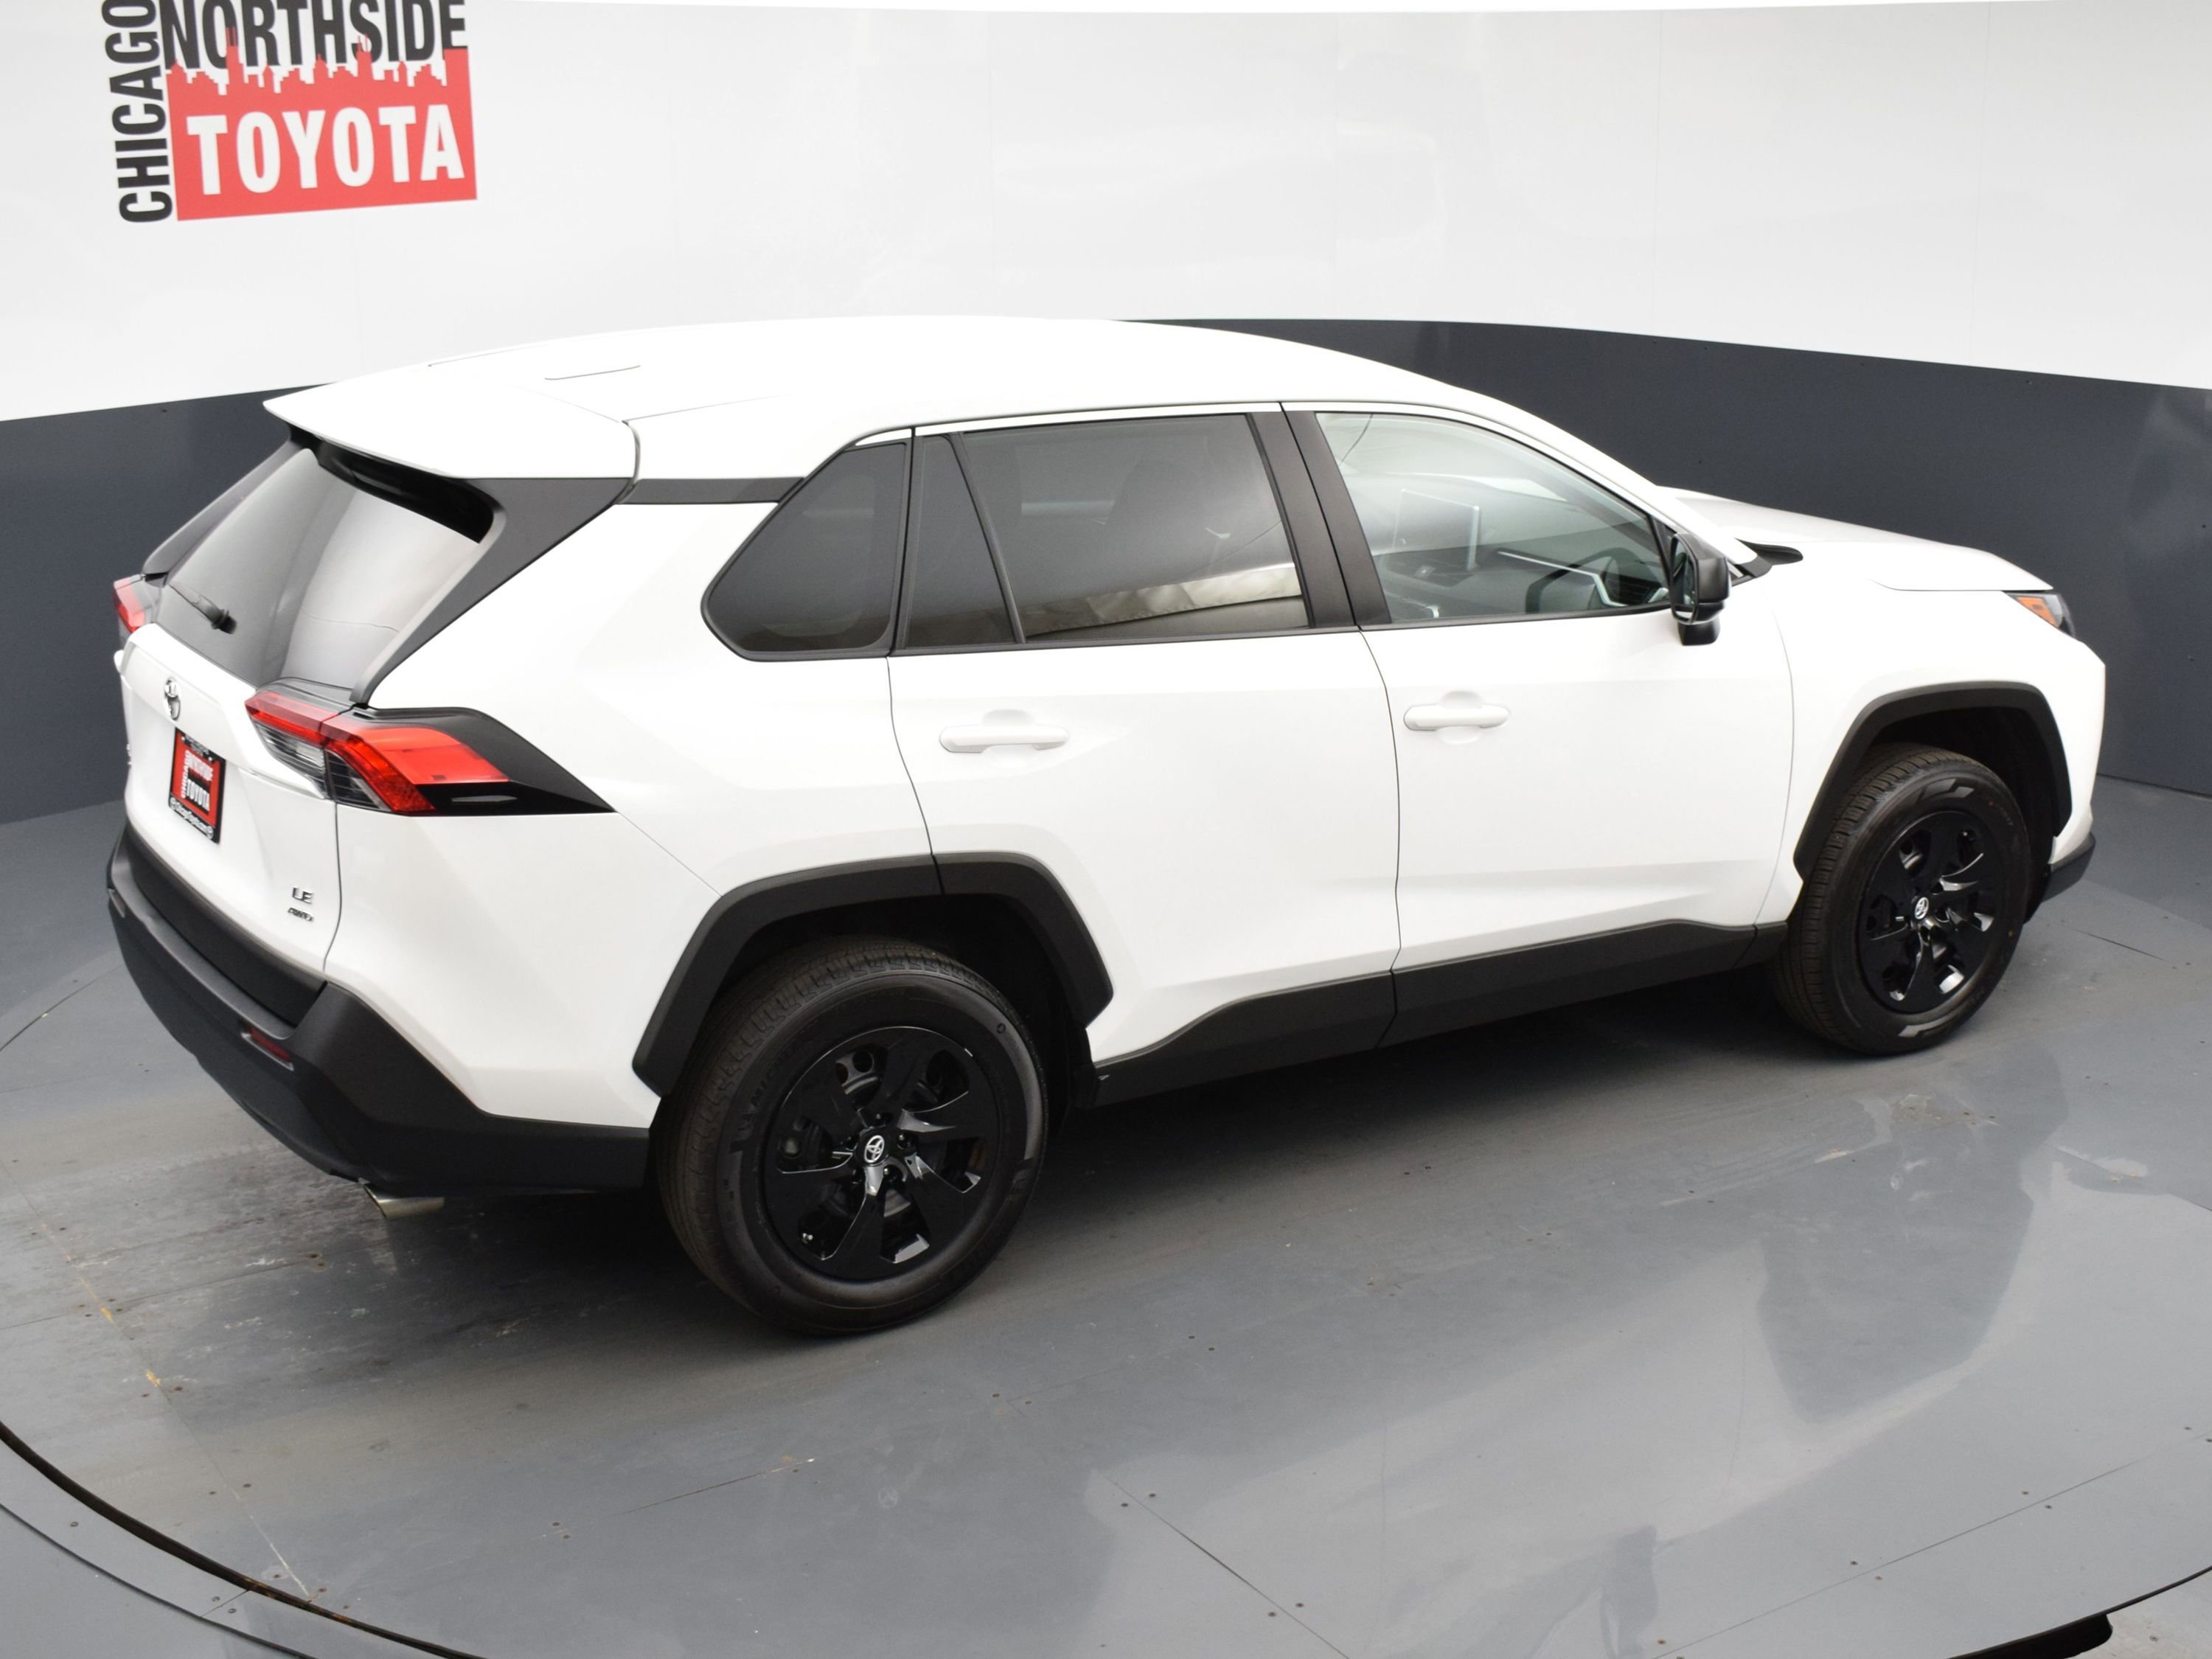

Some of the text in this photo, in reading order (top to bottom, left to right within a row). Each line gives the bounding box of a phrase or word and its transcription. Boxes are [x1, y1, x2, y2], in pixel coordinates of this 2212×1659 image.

[159, 0, 467, 70] NORTHSIDE
[102, 0, 173, 223] CHICAGO
[187, 104, 465, 195] TOYOTA
[291, 886, 313, 905] LE
